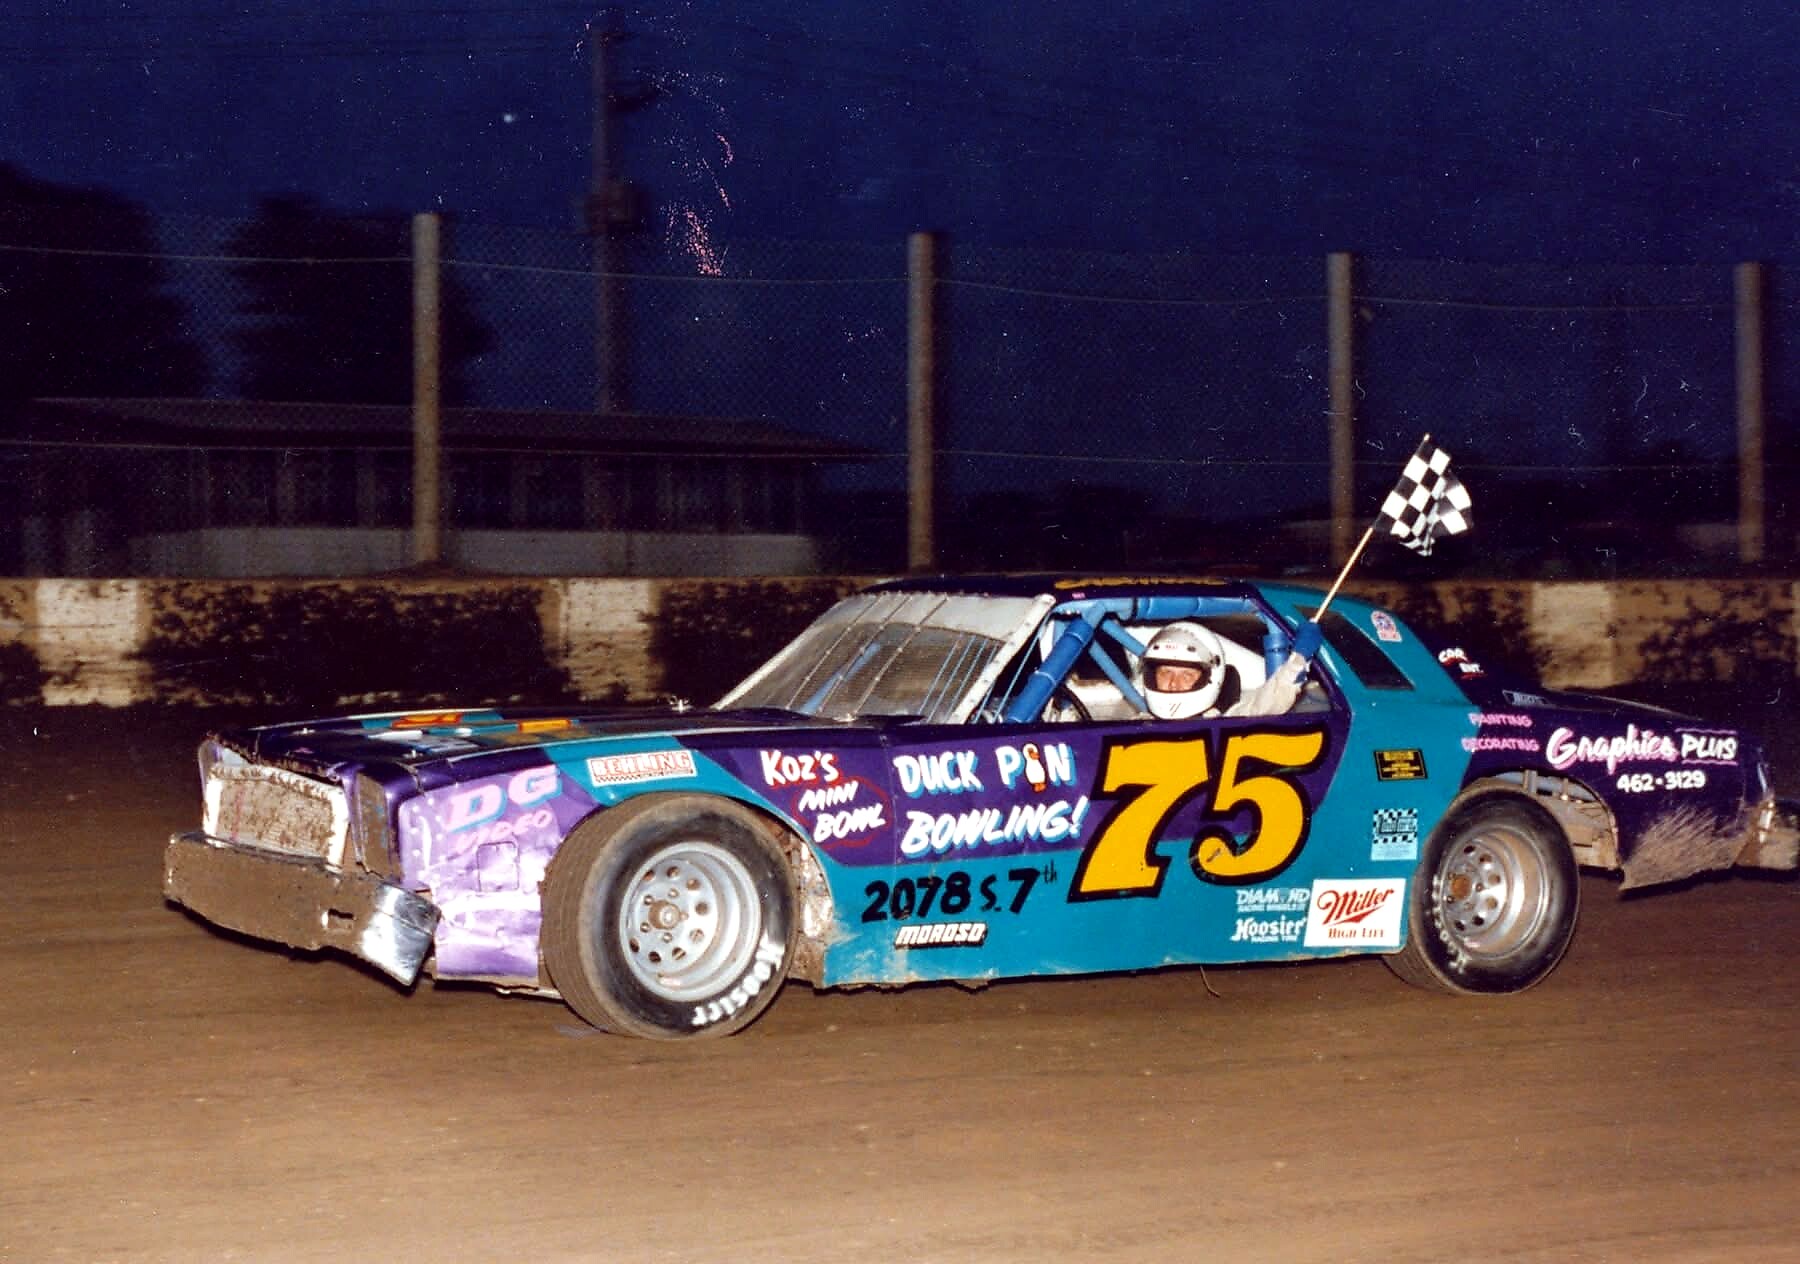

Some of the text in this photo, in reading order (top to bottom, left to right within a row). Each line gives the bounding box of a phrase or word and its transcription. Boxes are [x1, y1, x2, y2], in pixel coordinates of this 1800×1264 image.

[1467, 713, 1533, 727] PAINTING
[1461, 737, 1540, 753] DECORATING
[1546, 723, 1737, 775] Graphics PLUS
[591, 751, 692, 776] BEHLING
[893, 750, 983, 796] DUCK
[798, 781, 858, 811] MINI
[814, 804, 886, 842] BOWL
[901, 795, 1089, 857] BOWLING!
[1072, 727, 1328, 900] 75
[862, 872, 971, 923] 2078
[1008, 860, 1058, 914] 7th
[1236, 888, 1310, 905] DIAMND
[1317, 888, 1394, 925] Miller
[895, 923, 987, 947] MOROSO
[1229, 914, 1308, 941] Hoosier
